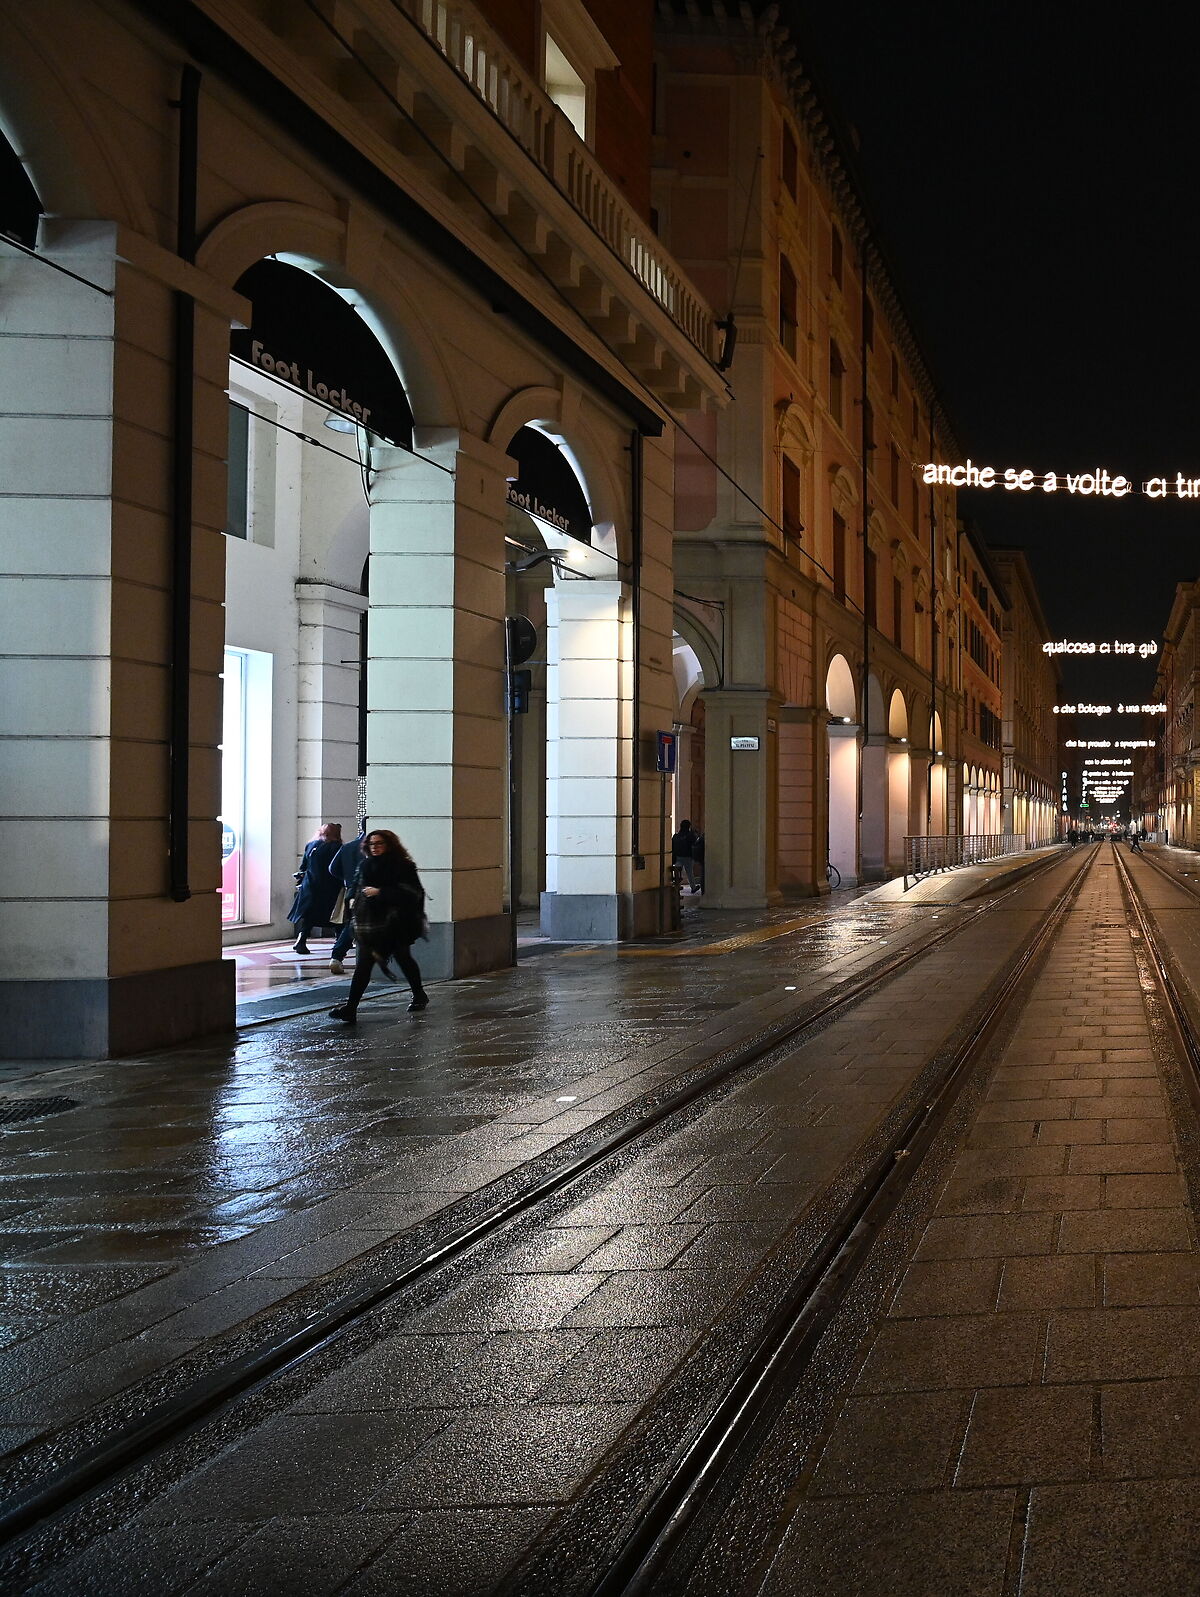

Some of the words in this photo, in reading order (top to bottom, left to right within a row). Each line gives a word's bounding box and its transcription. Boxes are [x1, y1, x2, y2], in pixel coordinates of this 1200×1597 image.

[252, 340, 301, 386] Foot
[307, 369, 371, 424] Locker
[923, 459, 996, 489] anche
[1004, 467, 1034, 491] se
[1042, 471, 1058, 492] a
[1066, 467, 1127, 497] volte
[1145, 477, 1167, 498] ci
[506, 482, 531, 510] Foot
[534, 497, 570, 531] Locker
[1042, 639, 1096, 657] qualcosa
[1100, 642, 1110, 654] ci
[1115, 640, 1135, 654] tira
[1139, 640, 1158, 659] giù
[1061, 704, 1076, 714] che
